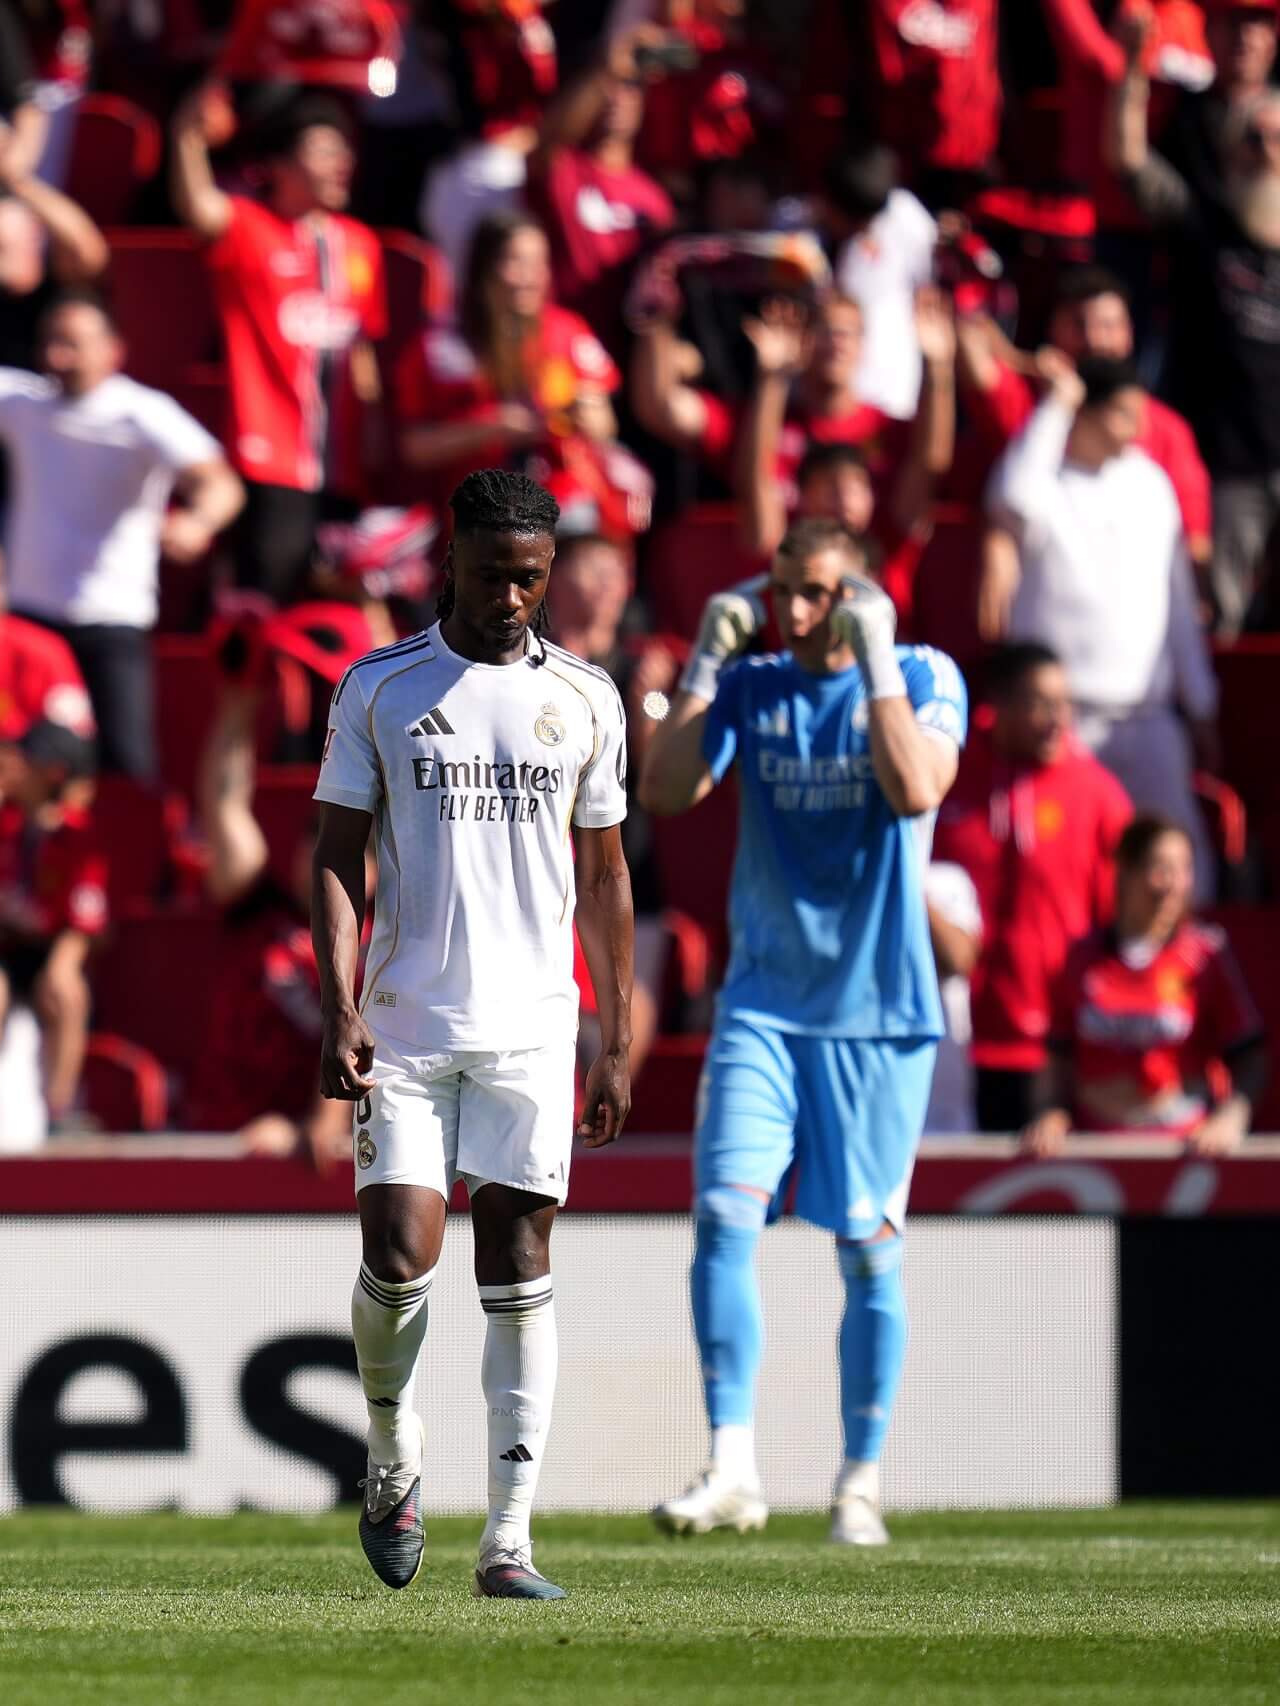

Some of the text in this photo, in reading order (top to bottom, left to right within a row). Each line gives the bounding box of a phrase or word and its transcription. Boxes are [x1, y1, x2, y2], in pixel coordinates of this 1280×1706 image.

[410, 755, 561, 793] Emirates
[439, 795, 539, 823] FLY BETTER
